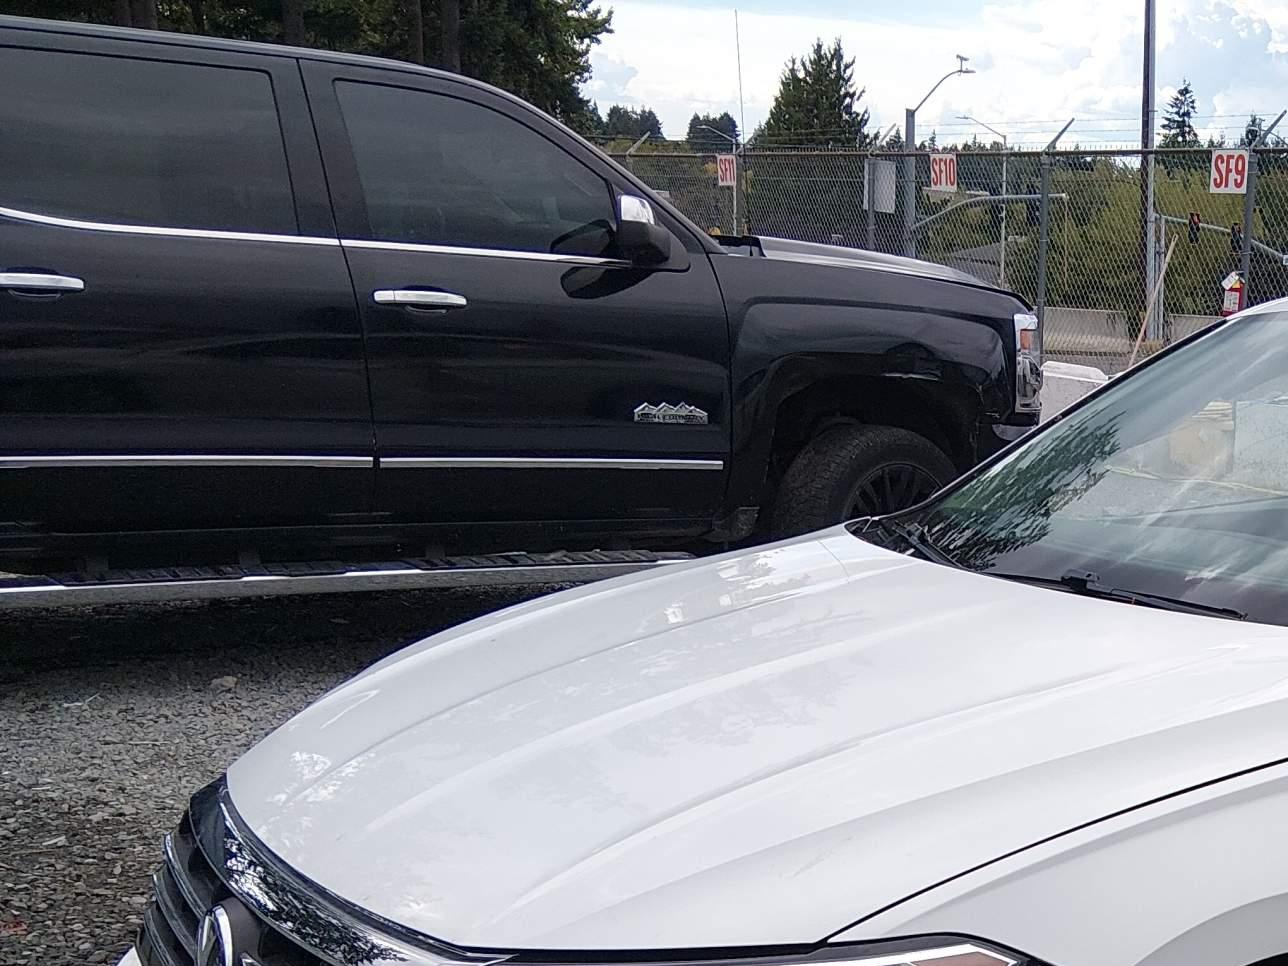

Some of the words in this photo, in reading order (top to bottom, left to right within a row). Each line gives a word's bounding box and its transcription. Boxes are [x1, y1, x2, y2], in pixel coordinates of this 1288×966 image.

[719, 158, 736, 183] SF11
[931, 157, 956, 187] SF10
[1213, 153, 1246, 189] SF9
